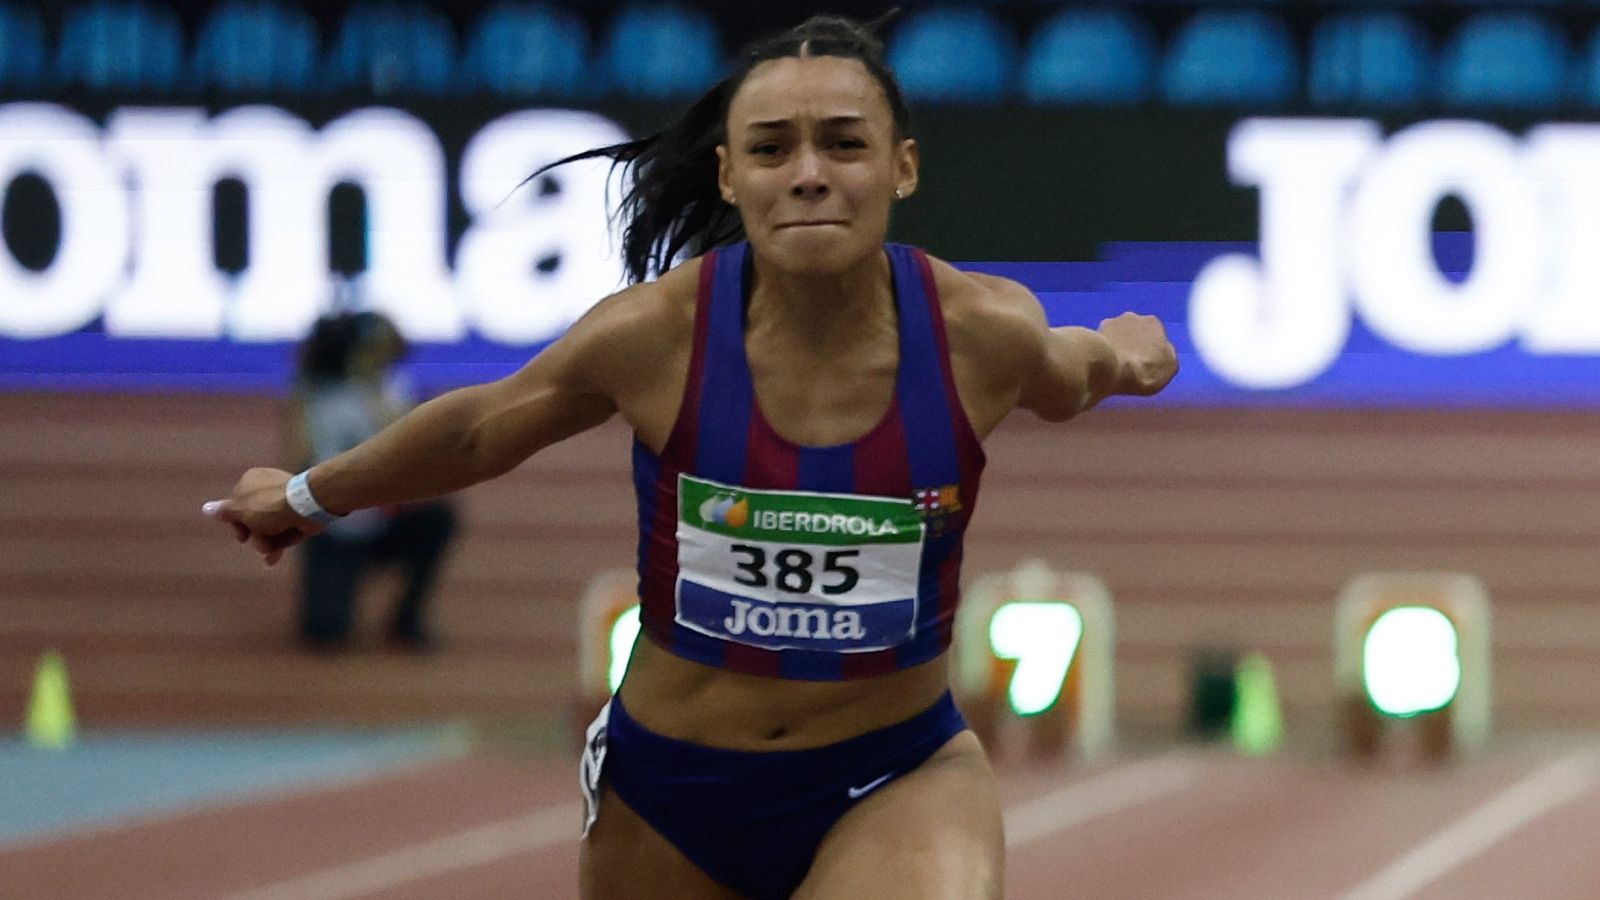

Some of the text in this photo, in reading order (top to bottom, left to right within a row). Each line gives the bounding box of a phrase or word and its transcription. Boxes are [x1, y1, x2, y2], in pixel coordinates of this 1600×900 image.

[753, 509, 899, 537] IBERDROLA
[730, 543, 861, 596] 385
[723, 599, 867, 641] Joma
[989, 600, 1083, 717] 7
